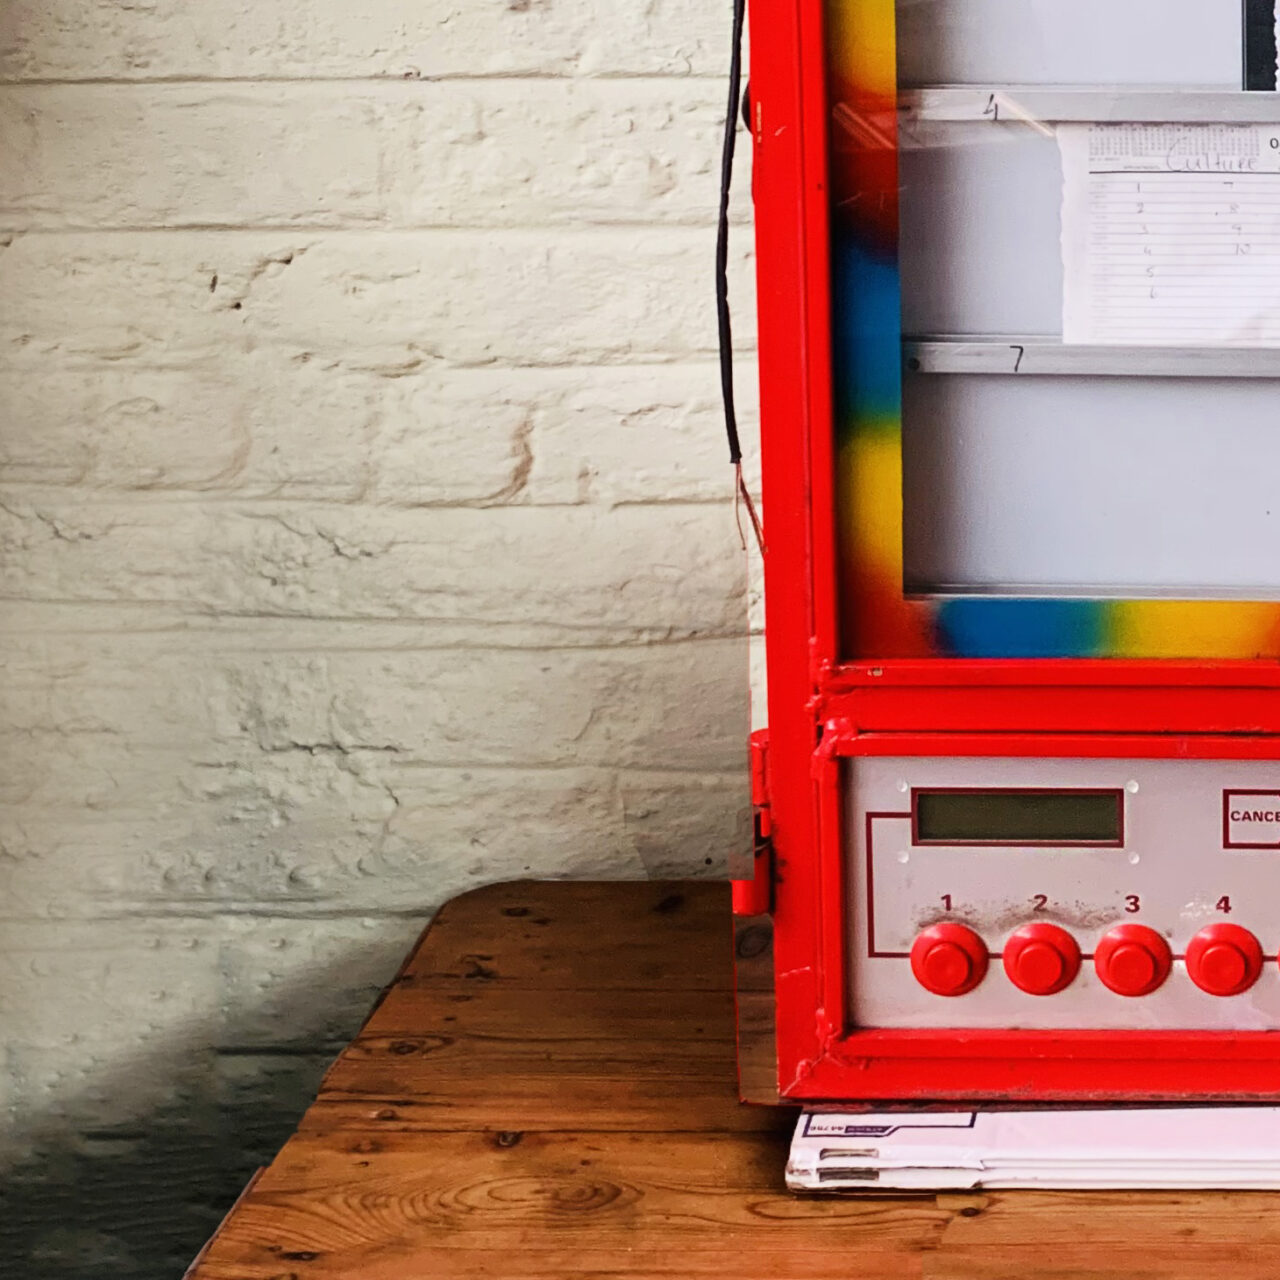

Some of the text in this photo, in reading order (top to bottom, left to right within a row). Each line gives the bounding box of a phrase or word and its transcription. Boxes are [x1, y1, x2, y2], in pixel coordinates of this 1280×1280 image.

[982, 94, 998, 120] 4
[1009, 345, 1024, 372] 7
[940, 894, 952, 911] 1
[1033, 894, 1048, 911] 2
[1125, 895, 1141, 913] 3
[1216, 896, 1232, 914] 4
